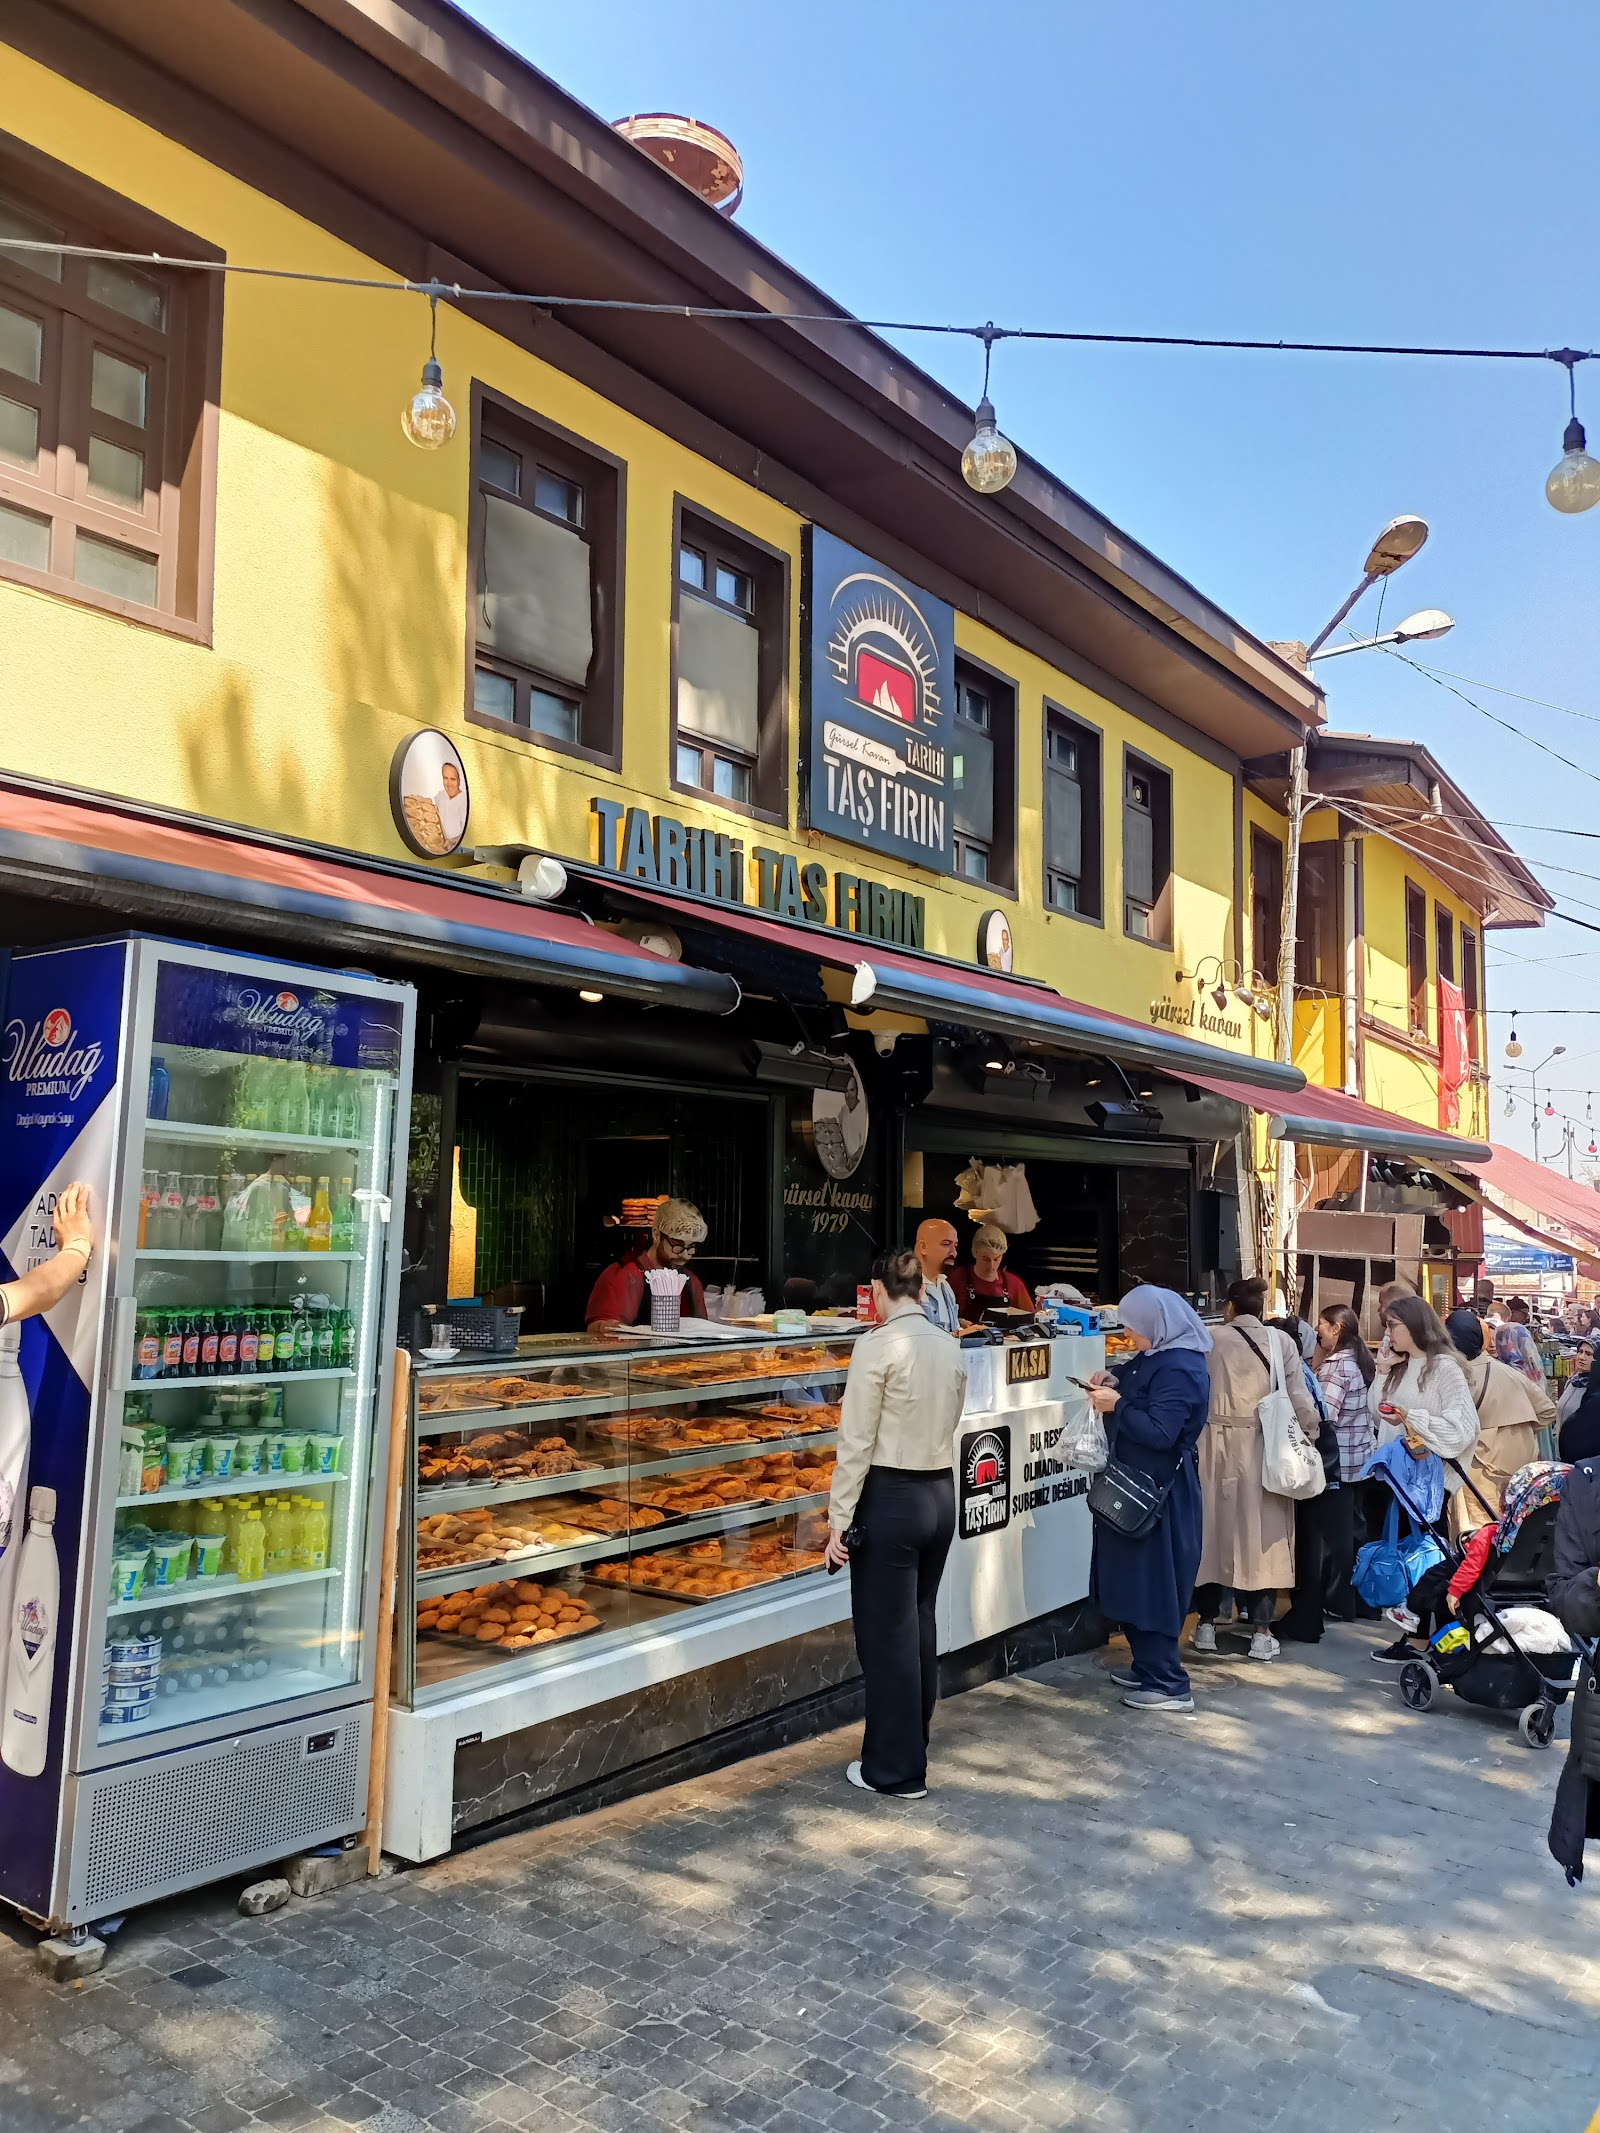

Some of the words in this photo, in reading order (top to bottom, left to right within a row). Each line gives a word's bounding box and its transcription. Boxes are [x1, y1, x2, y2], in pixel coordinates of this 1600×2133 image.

[829, 728, 859, 751] Gürsel
[862, 741, 891, 765] Kavan
[905, 737, 945, 778] TARİHİ
[823, 753, 875, 837] TAŞ
[880, 777, 945, 852] FIRIN
[834, 872, 925, 950] FIRIN
[237, 988, 325, 1042] Uludağ
[1149, 995, 1195, 1027] gürsel
[2, 1018, 105, 1101] Uludağ
[25, 1080, 71, 1096] PREMIUM
[35, 1192, 58, 1216] AD
[812, 1211, 849, 1233] 1979
[1011, 1349, 1047, 1379] KASA
[1029, 1432, 1042, 1453] BU
[965, 1506, 983, 1533] TAŞ
[983, 1499, 1007, 1526] FIRIN
[1012, 1484, 1050, 1518] ŞUBEMİZ
